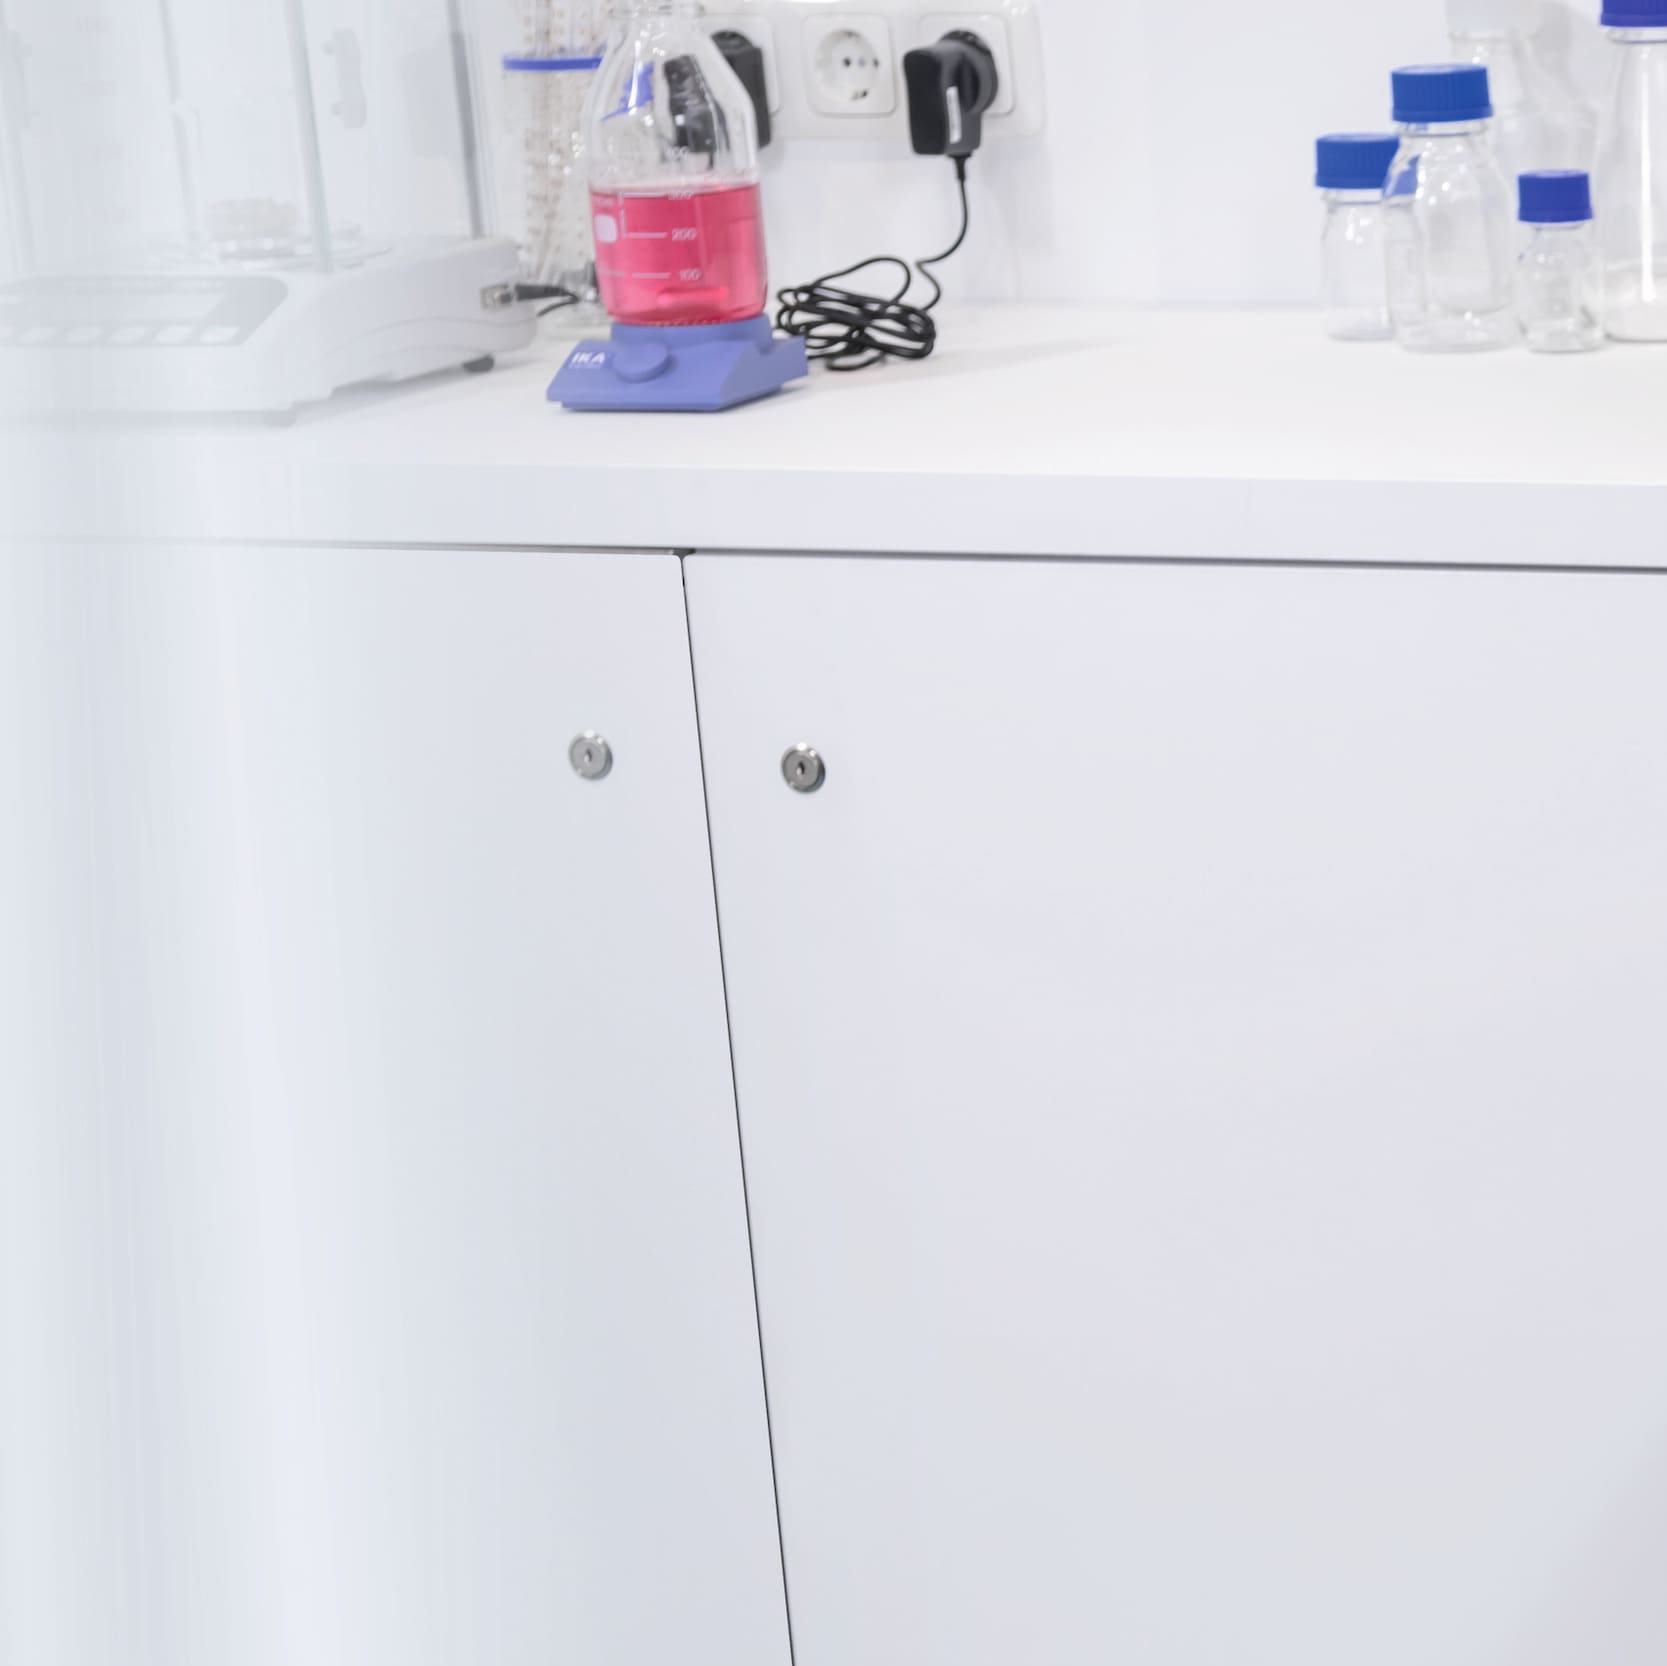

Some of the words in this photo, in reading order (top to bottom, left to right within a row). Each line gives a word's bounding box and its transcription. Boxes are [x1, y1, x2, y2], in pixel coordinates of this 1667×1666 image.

[671, 228, 697, 241] 200
[679, 269, 702, 281] 100
[571, 352, 606, 365] IKA
